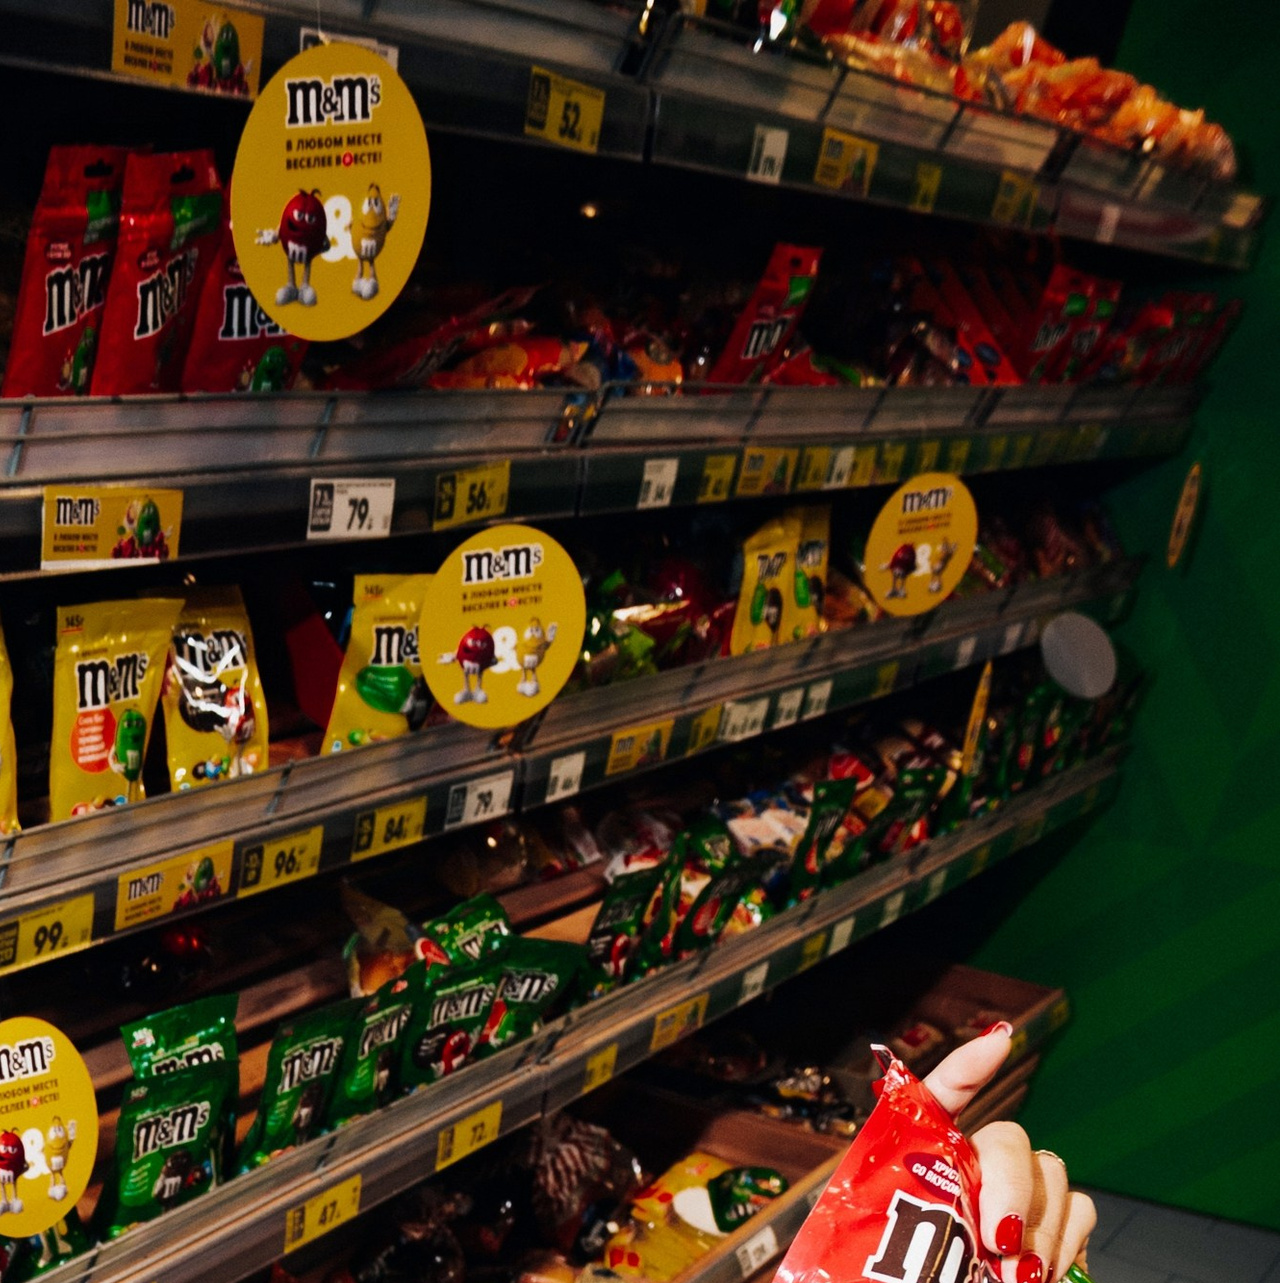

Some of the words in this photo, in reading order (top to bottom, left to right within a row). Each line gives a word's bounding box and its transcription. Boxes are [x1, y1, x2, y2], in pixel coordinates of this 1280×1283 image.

[285, 72, 382, 129] m&m's
[286, 139, 293, 152] В
[296, 136, 343, 151] ЛЮБОМ
[346, 133, 382, 147] МЕСТЕ
[286, 155, 332, 170] ВЕСЕЛЕЕ
[287, 241, 307, 262] m
[346, 497, 370, 532] 79
[462, 543, 544, 586] m&m's
[383, 813, 405, 843] 84
[274, 851, 296, 878] 96
[34, 921, 63, 956] 99
[33, 1079, 59, 1093] МЕСТЕ
[912, 1162, 927, 1177] СО
[926, 1170, 962, 1198] ВКУСОМ
